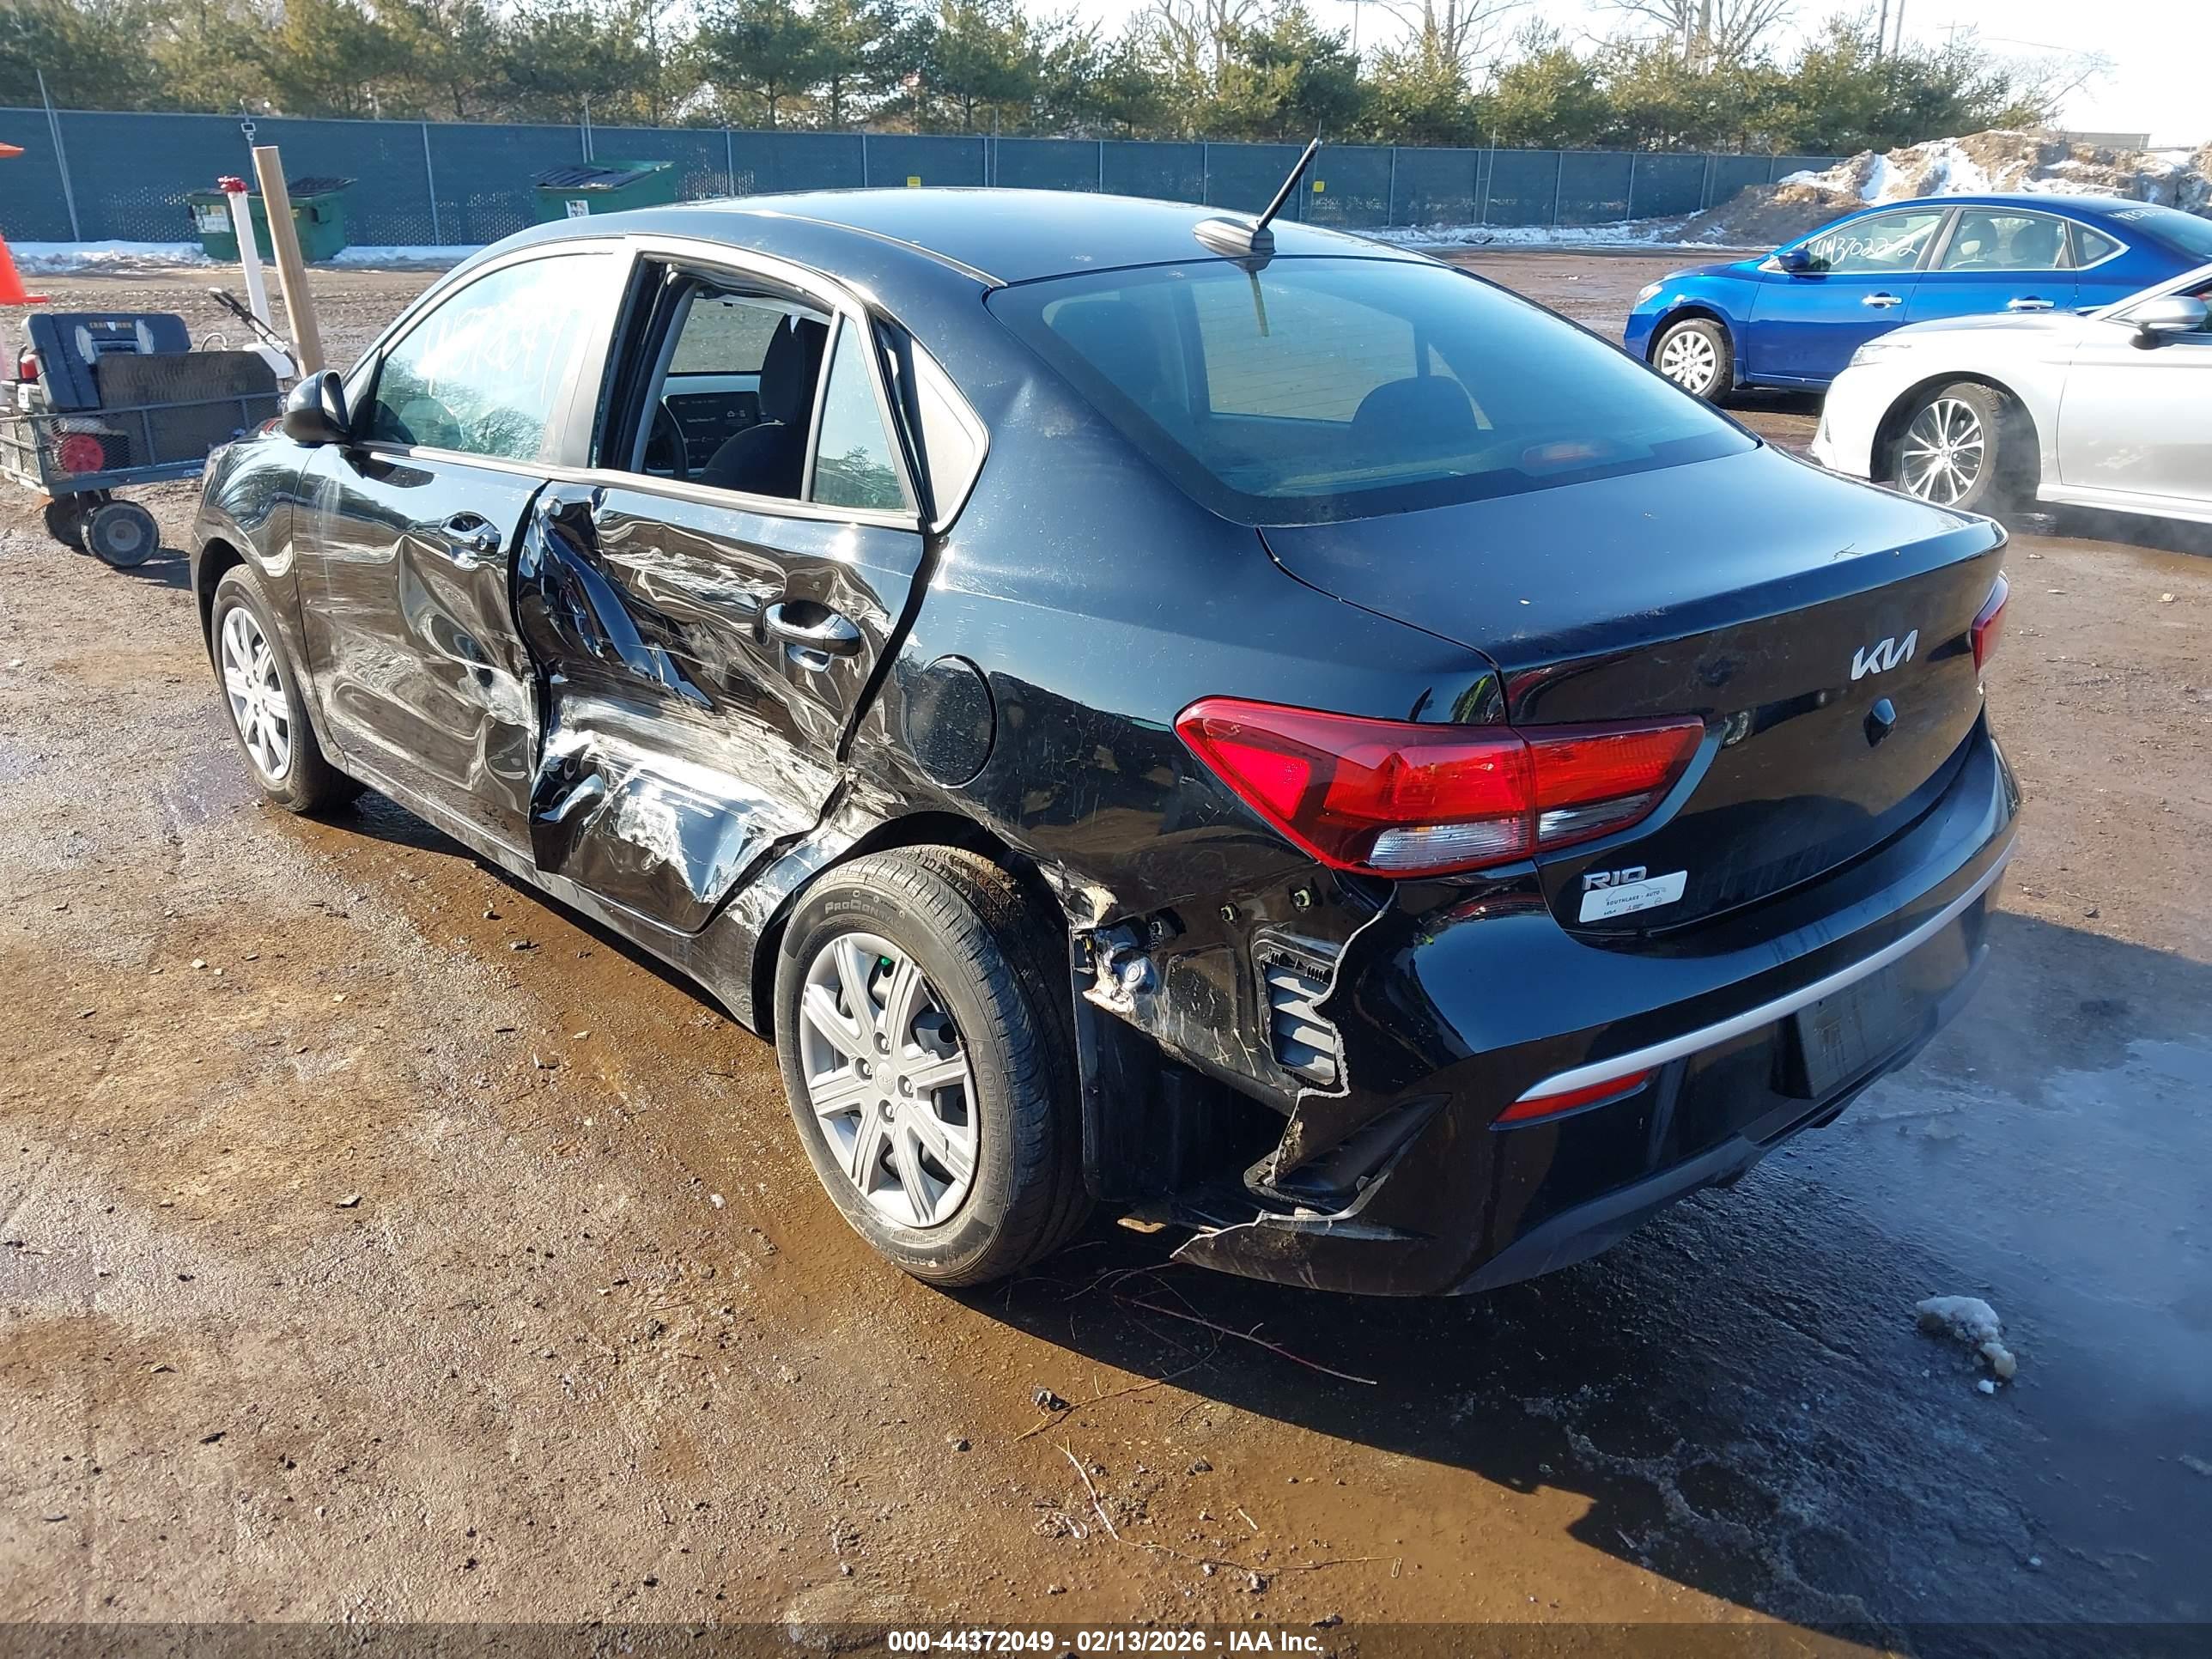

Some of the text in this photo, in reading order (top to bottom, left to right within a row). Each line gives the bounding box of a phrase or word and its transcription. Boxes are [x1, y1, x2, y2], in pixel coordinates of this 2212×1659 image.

[88, 321, 132, 330] CRAFMAN
[1850, 629, 1919, 681] KIA
[1582, 866, 1648, 890] RIO
